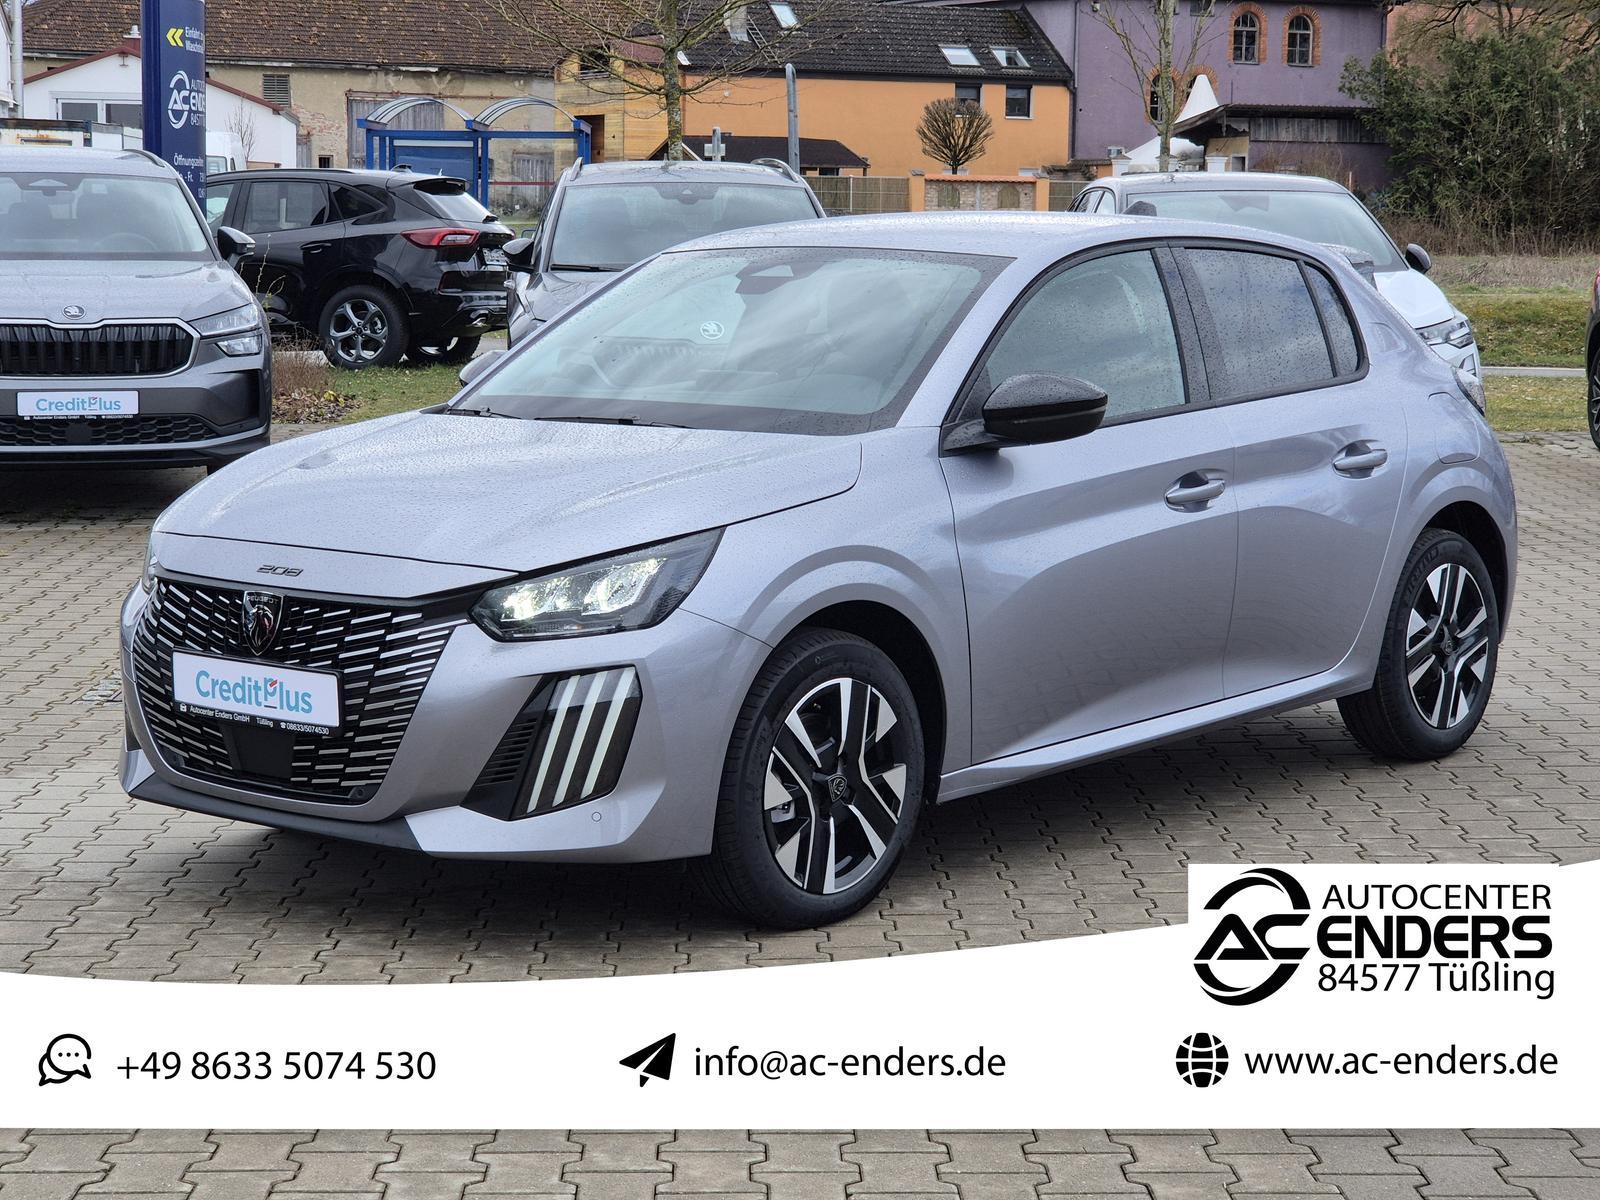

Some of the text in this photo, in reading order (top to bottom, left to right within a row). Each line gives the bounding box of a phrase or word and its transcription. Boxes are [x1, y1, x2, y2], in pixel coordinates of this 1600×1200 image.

[168, 89, 190, 111] AC
[36, 396, 121, 412] CreditPlus
[256, 564, 304, 577] 208
[195, 670, 313, 714] CreditPlus
[190, 705, 214, 717] Autocenter
[215, 709, 233, 720] Enders
[233, 713, 250, 722] GmbH
